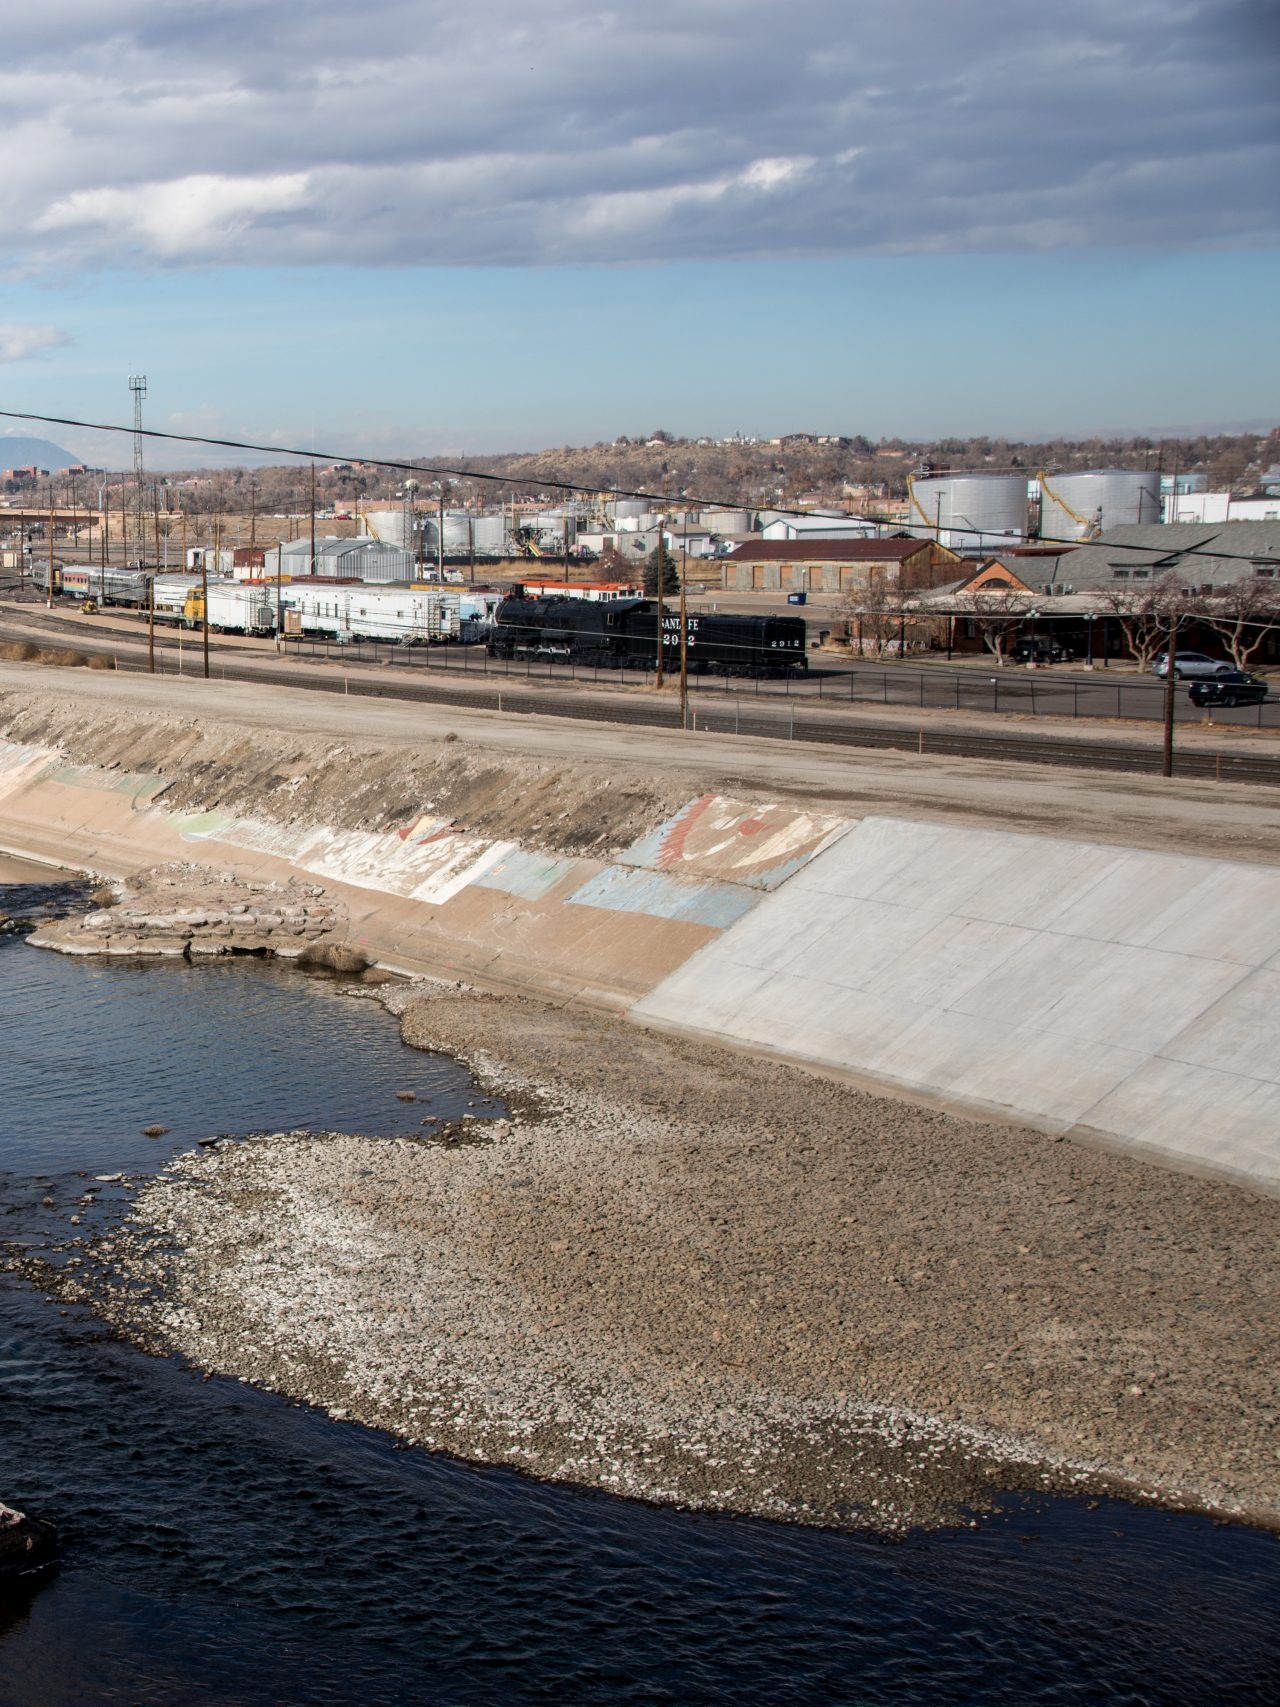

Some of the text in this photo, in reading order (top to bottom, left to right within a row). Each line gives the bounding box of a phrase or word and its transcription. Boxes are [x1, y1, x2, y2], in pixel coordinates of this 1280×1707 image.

[661, 618, 699, 630] SANT FE
[663, 634, 695, 646] 292
